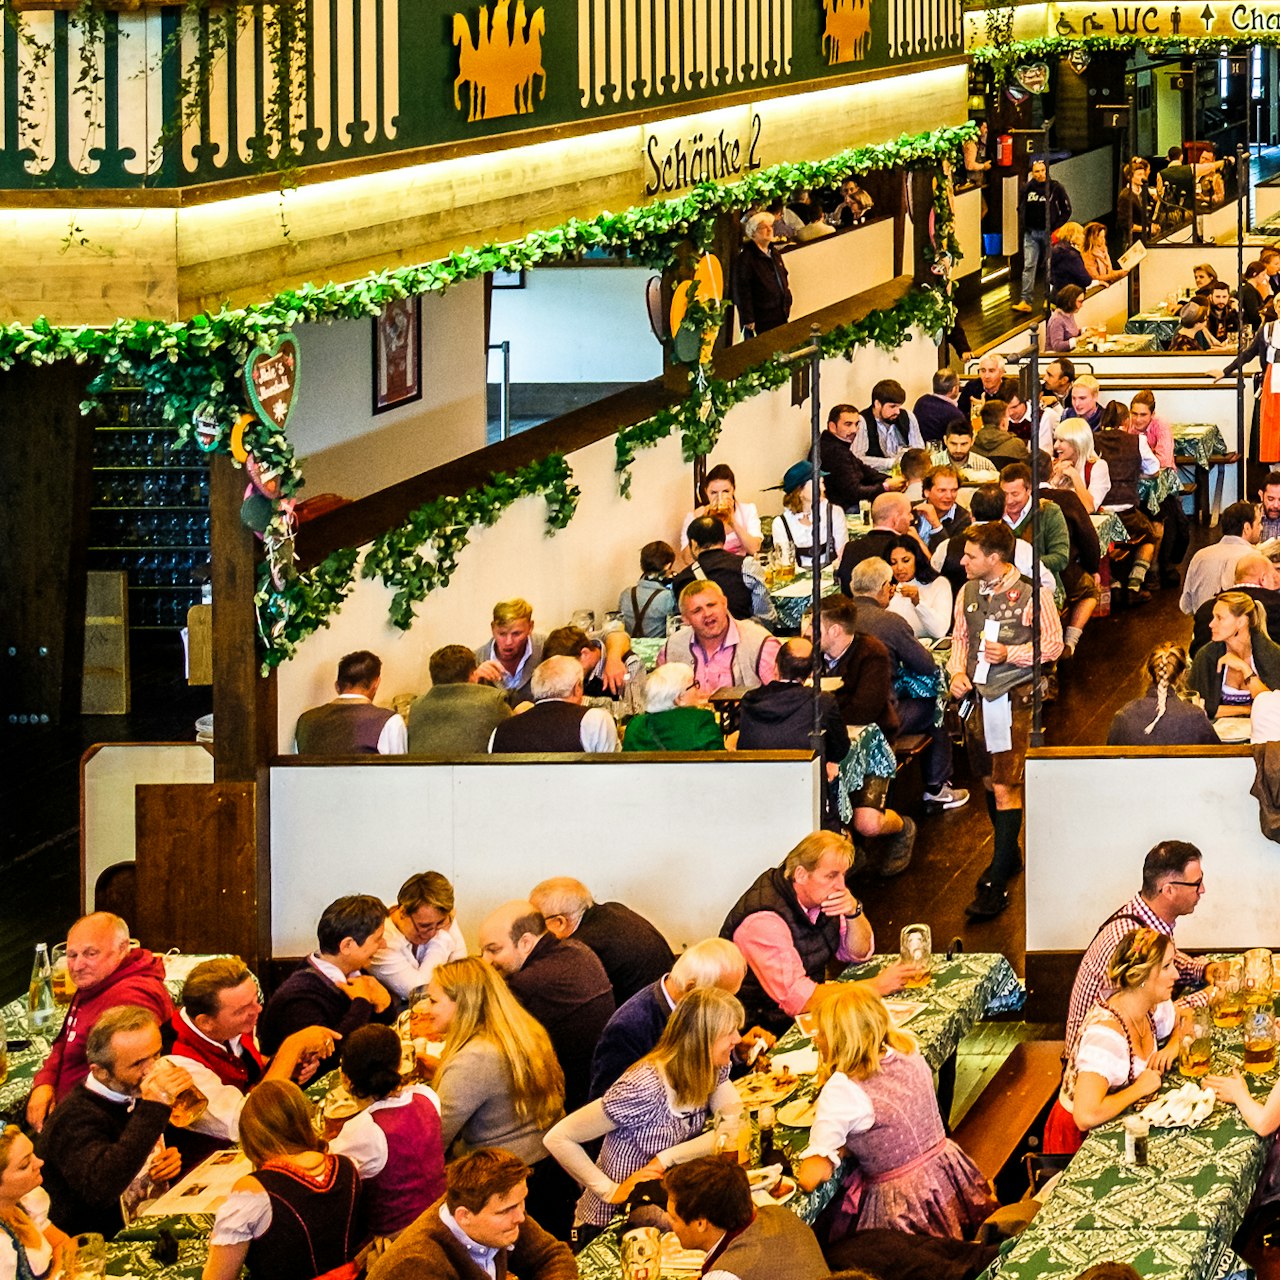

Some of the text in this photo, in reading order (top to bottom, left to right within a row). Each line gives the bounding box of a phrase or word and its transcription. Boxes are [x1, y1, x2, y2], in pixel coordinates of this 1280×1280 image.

[1112, 7, 1159, 35] WC
[646, 113, 762, 197] Schänke 2
